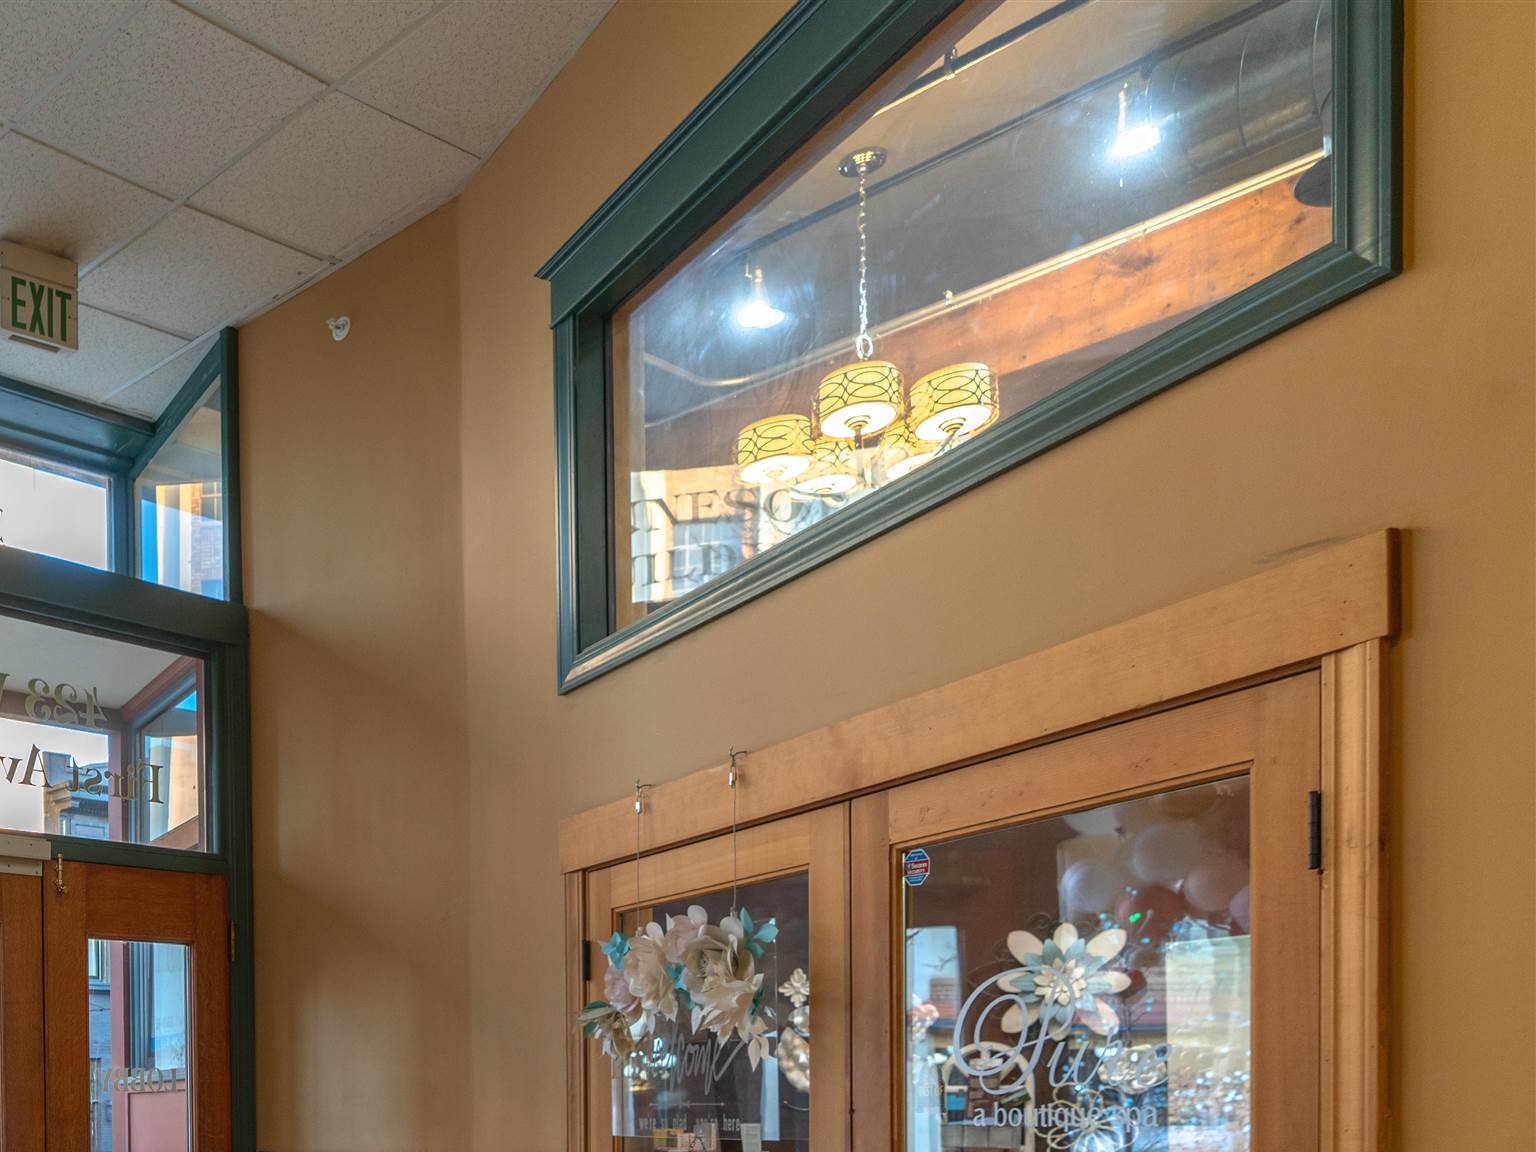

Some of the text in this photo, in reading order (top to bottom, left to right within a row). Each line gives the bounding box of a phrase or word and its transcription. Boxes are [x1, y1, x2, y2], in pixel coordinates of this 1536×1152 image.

[11, 276, 72, 342] EXIT
[953, 966, 1172, 1095] Pure
[972, 1102, 1158, 1132] a boutique spa
